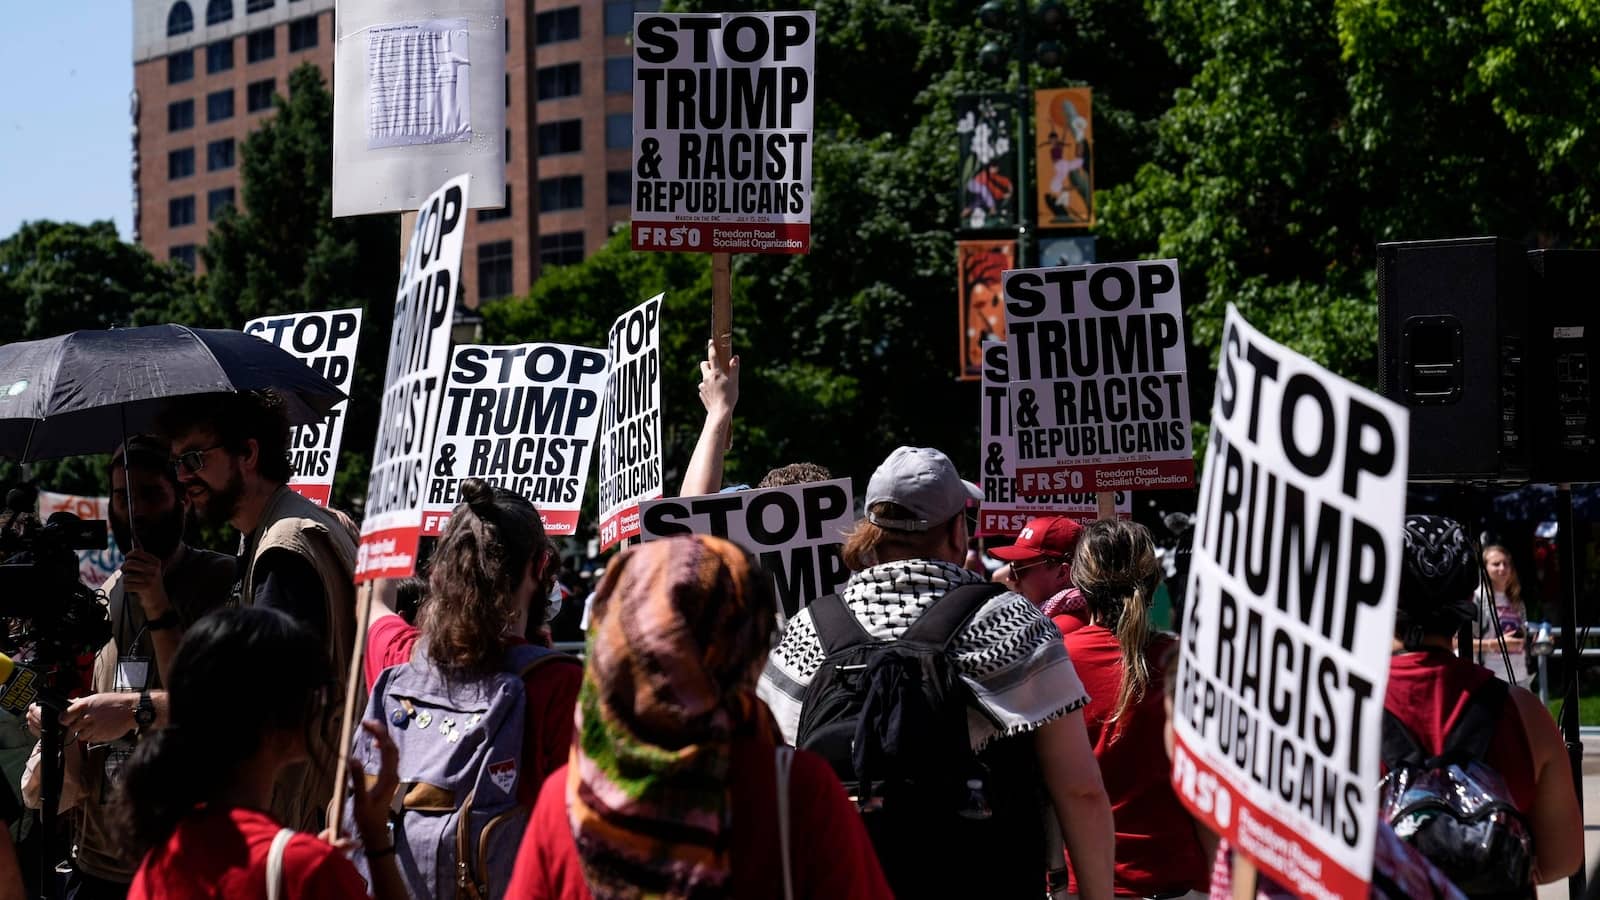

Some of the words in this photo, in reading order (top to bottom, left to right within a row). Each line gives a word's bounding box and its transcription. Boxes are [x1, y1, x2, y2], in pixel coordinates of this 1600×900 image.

[636, 15, 811, 64] STOP
[637, 66, 809, 130] TRUMP
[637, 137, 663, 179] &
[678, 133, 808, 181] RACIST
[636, 181, 804, 214] REPUBLICANS
[637, 224, 701, 247] FRSO
[712, 228, 753, 239] Freedom
[755, 229, 776, 239] Road
[712, 238, 751, 248] Socialist
[751, 239, 803, 250] Organization
[1005, 264, 1175, 317] STOP
[608, 299, 659, 374] STOP
[1009, 312, 1178, 380] TRUMP
[451, 345, 606, 385] STOP
[446, 386, 598, 436] TRUMP
[599, 347, 658, 435] TRUMP
[1016, 387, 1041, 428] &
[1053, 375, 1183, 426] RACIST
[1220, 322, 1396, 500] STOP
[434, 443, 456, 477] &
[468, 437, 589, 477] RACIST
[610, 409, 659, 478] RACIST
[984, 442, 1004, 476] &
[1018, 420, 1186, 459] REPUBLICANS
[600, 456, 660, 515] REPUBLICANS
[1022, 469, 1084, 492] FRSO
[1096, 469, 1134, 478] Freedom
[1136, 467, 1158, 476] Road
[1096, 477, 1133, 487] Socialist
[1133, 475, 1187, 486] Organization
[643, 485, 848, 546] STOP
[1203, 427, 1387, 653] TRUMP
[1214, 587, 1374, 776] RACIST
[1180, 658, 1363, 848] REPUBLICANS
